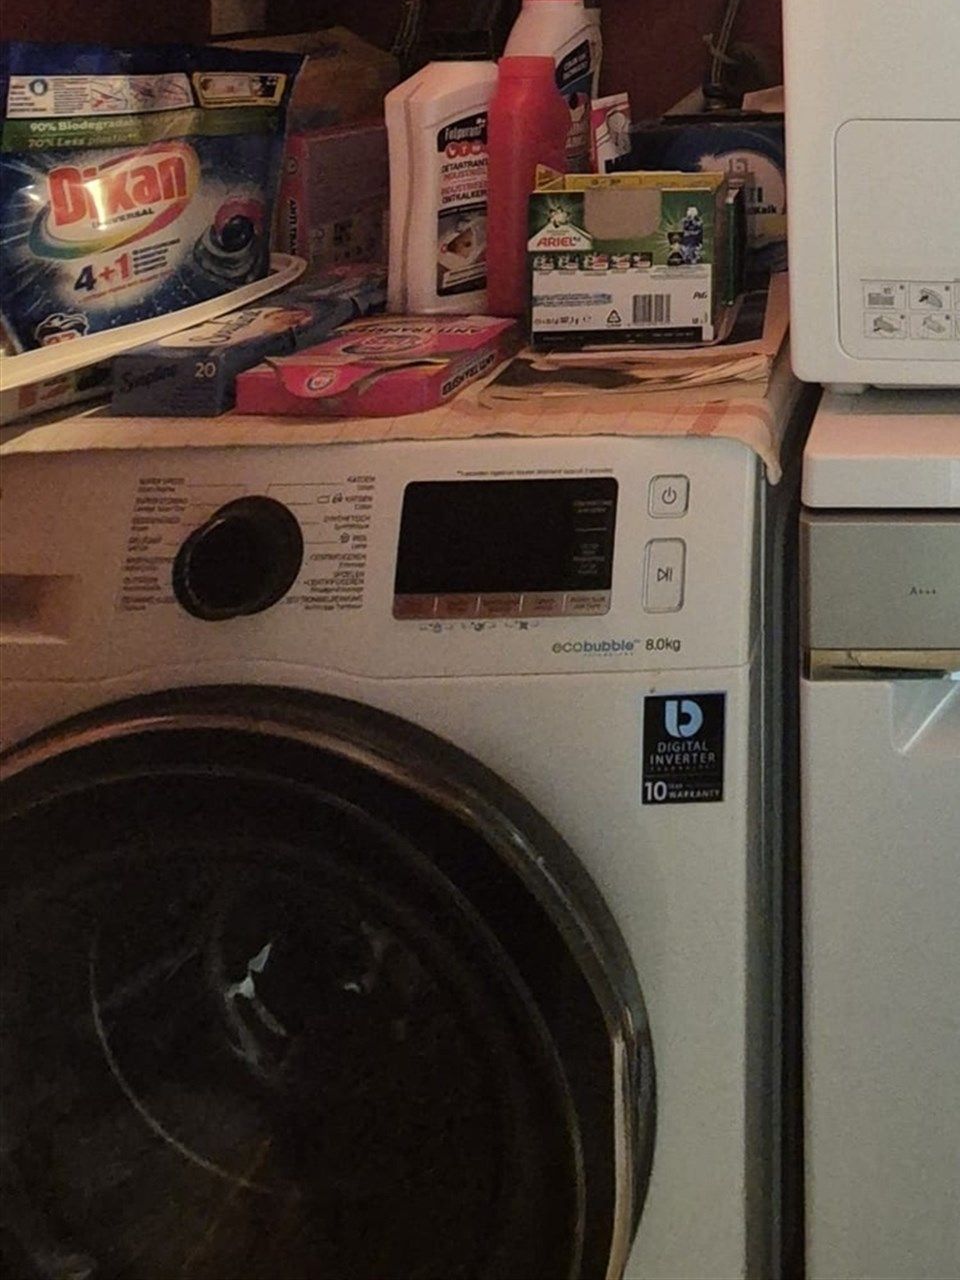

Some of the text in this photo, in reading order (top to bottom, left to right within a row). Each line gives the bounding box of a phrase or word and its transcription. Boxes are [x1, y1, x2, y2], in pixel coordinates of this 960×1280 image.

[49, 156, 188, 227] Dixan
[536, 235, 576, 248] ARIEL
[194, 361, 217, 379] 20
[644, 637, 682, 653] 8.0kg
[657, 740, 709, 753] DIGITAL
[649, 752, 717, 765] INVERTER
[644, 780, 668, 801] 10
[668, 789, 720, 799] WARRANTY
